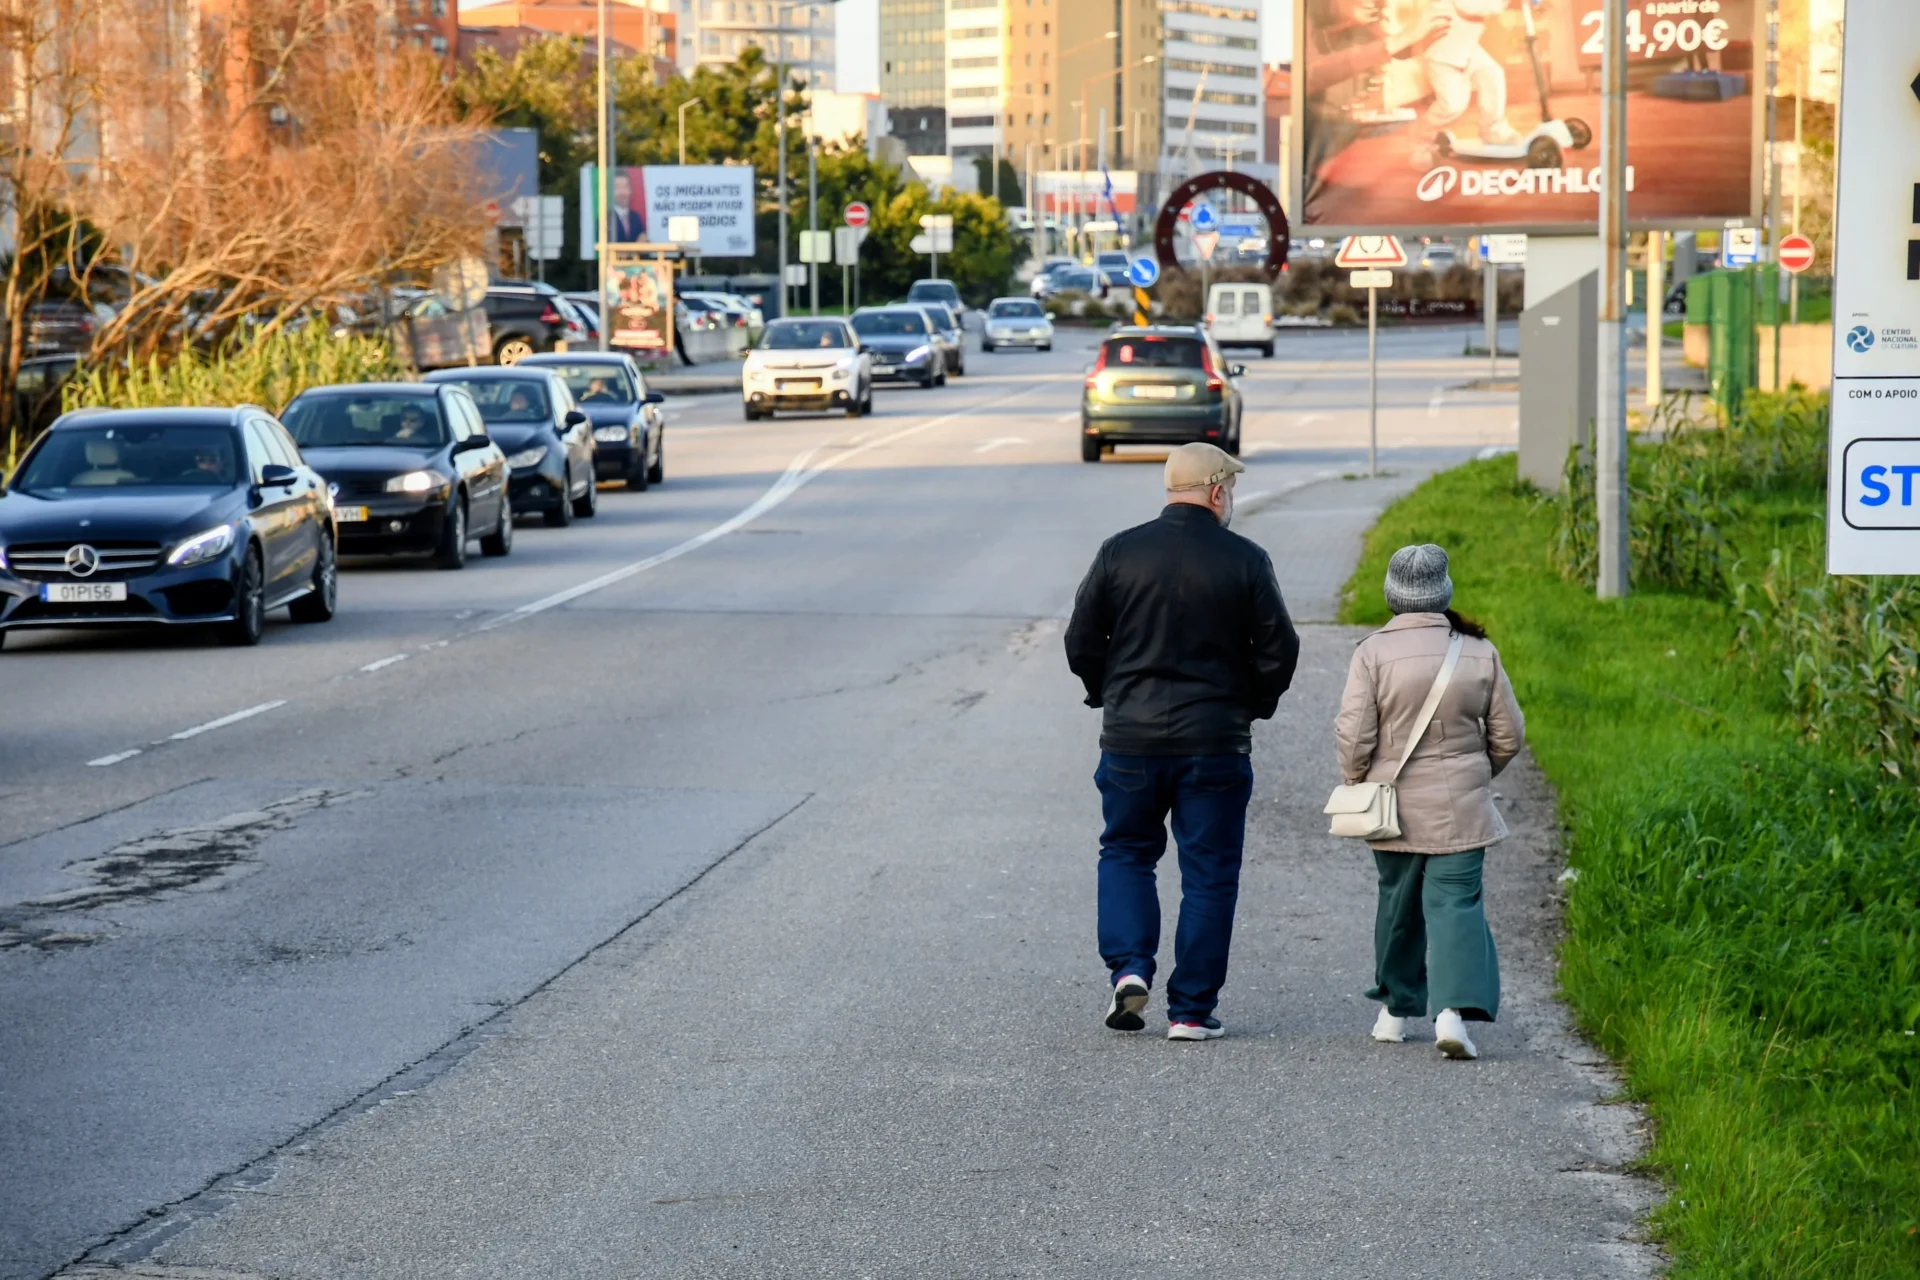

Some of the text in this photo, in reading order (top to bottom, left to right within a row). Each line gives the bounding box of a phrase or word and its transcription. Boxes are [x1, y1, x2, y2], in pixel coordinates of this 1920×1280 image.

[1656, 1, 1699, 17] partir
[1881, 328, 1911, 336] CENTRO
[1849, 389, 1918, 398] COM O APOIO
[1859, 465, 1920, 507] ST
